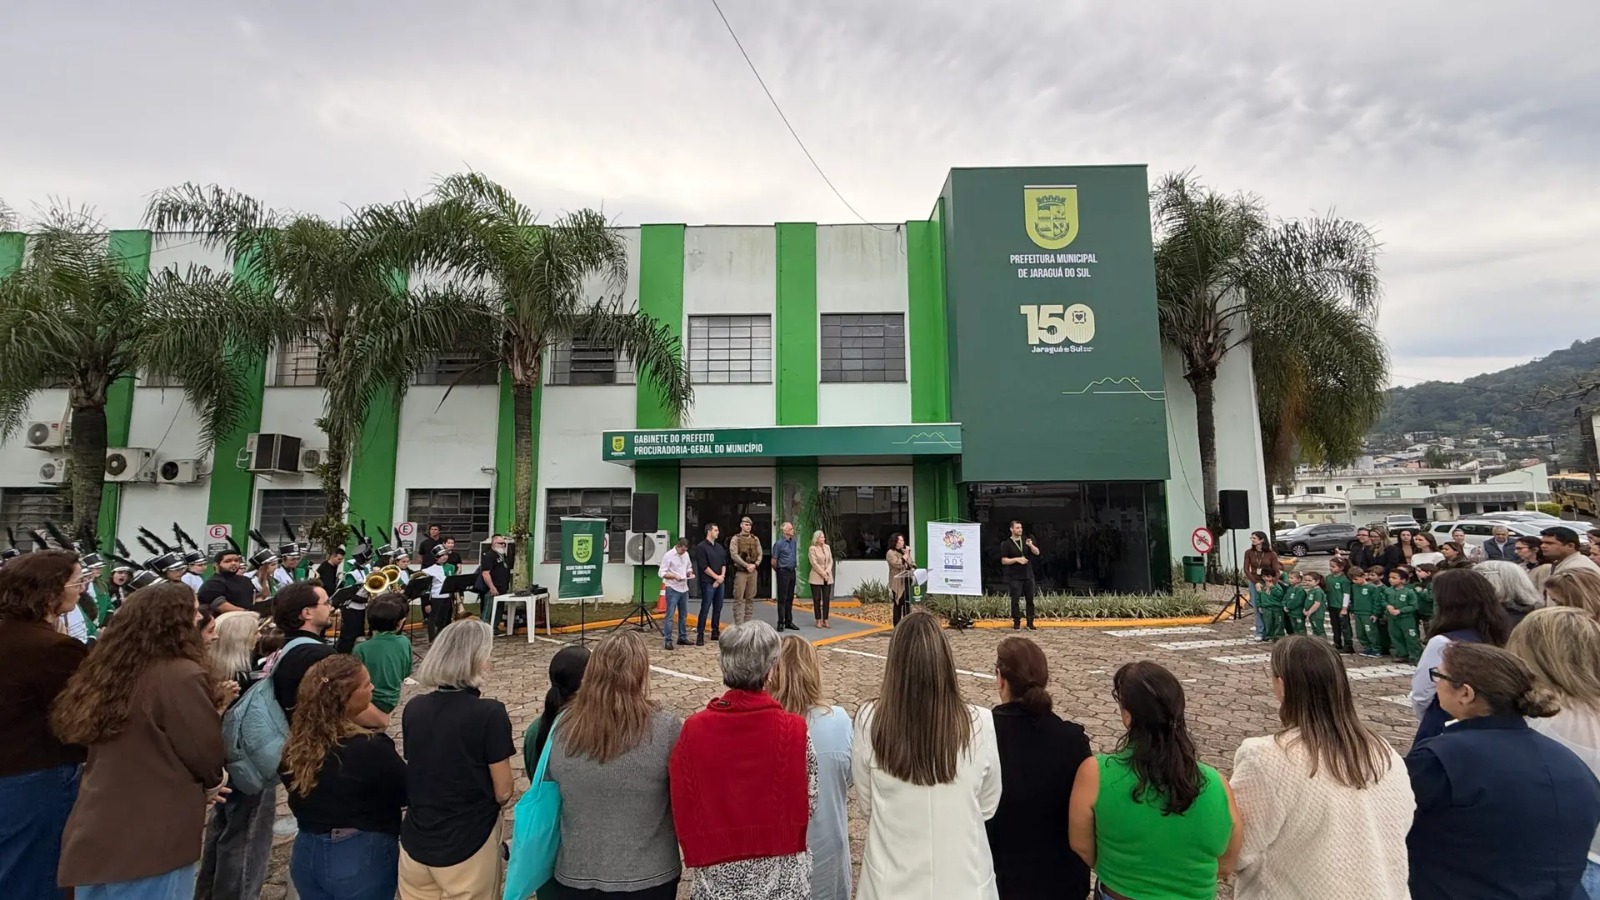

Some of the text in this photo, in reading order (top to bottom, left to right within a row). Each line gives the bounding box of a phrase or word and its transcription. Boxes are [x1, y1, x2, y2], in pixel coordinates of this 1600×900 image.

[1010, 253, 1098, 264] PREFEITURA MUNICIPAL
[1018, 266, 1091, 278] DE JARAGUÁ DO SUL
[1020, 303, 1095, 345] 150
[1031, 345, 1063, 354] Jaraguá
[1070, 345, 1083, 353] Sul
[634, 433, 715, 444] GABINETE DO PREFEITO
[634, 444, 714, 456] PROCURADORIA-GERAL
[715, 445, 725, 454] DO
[726, 442, 763, 453] MUNICÍPIO
[214, 528, 222, 536] E
[402, 525, 409, 533] E
